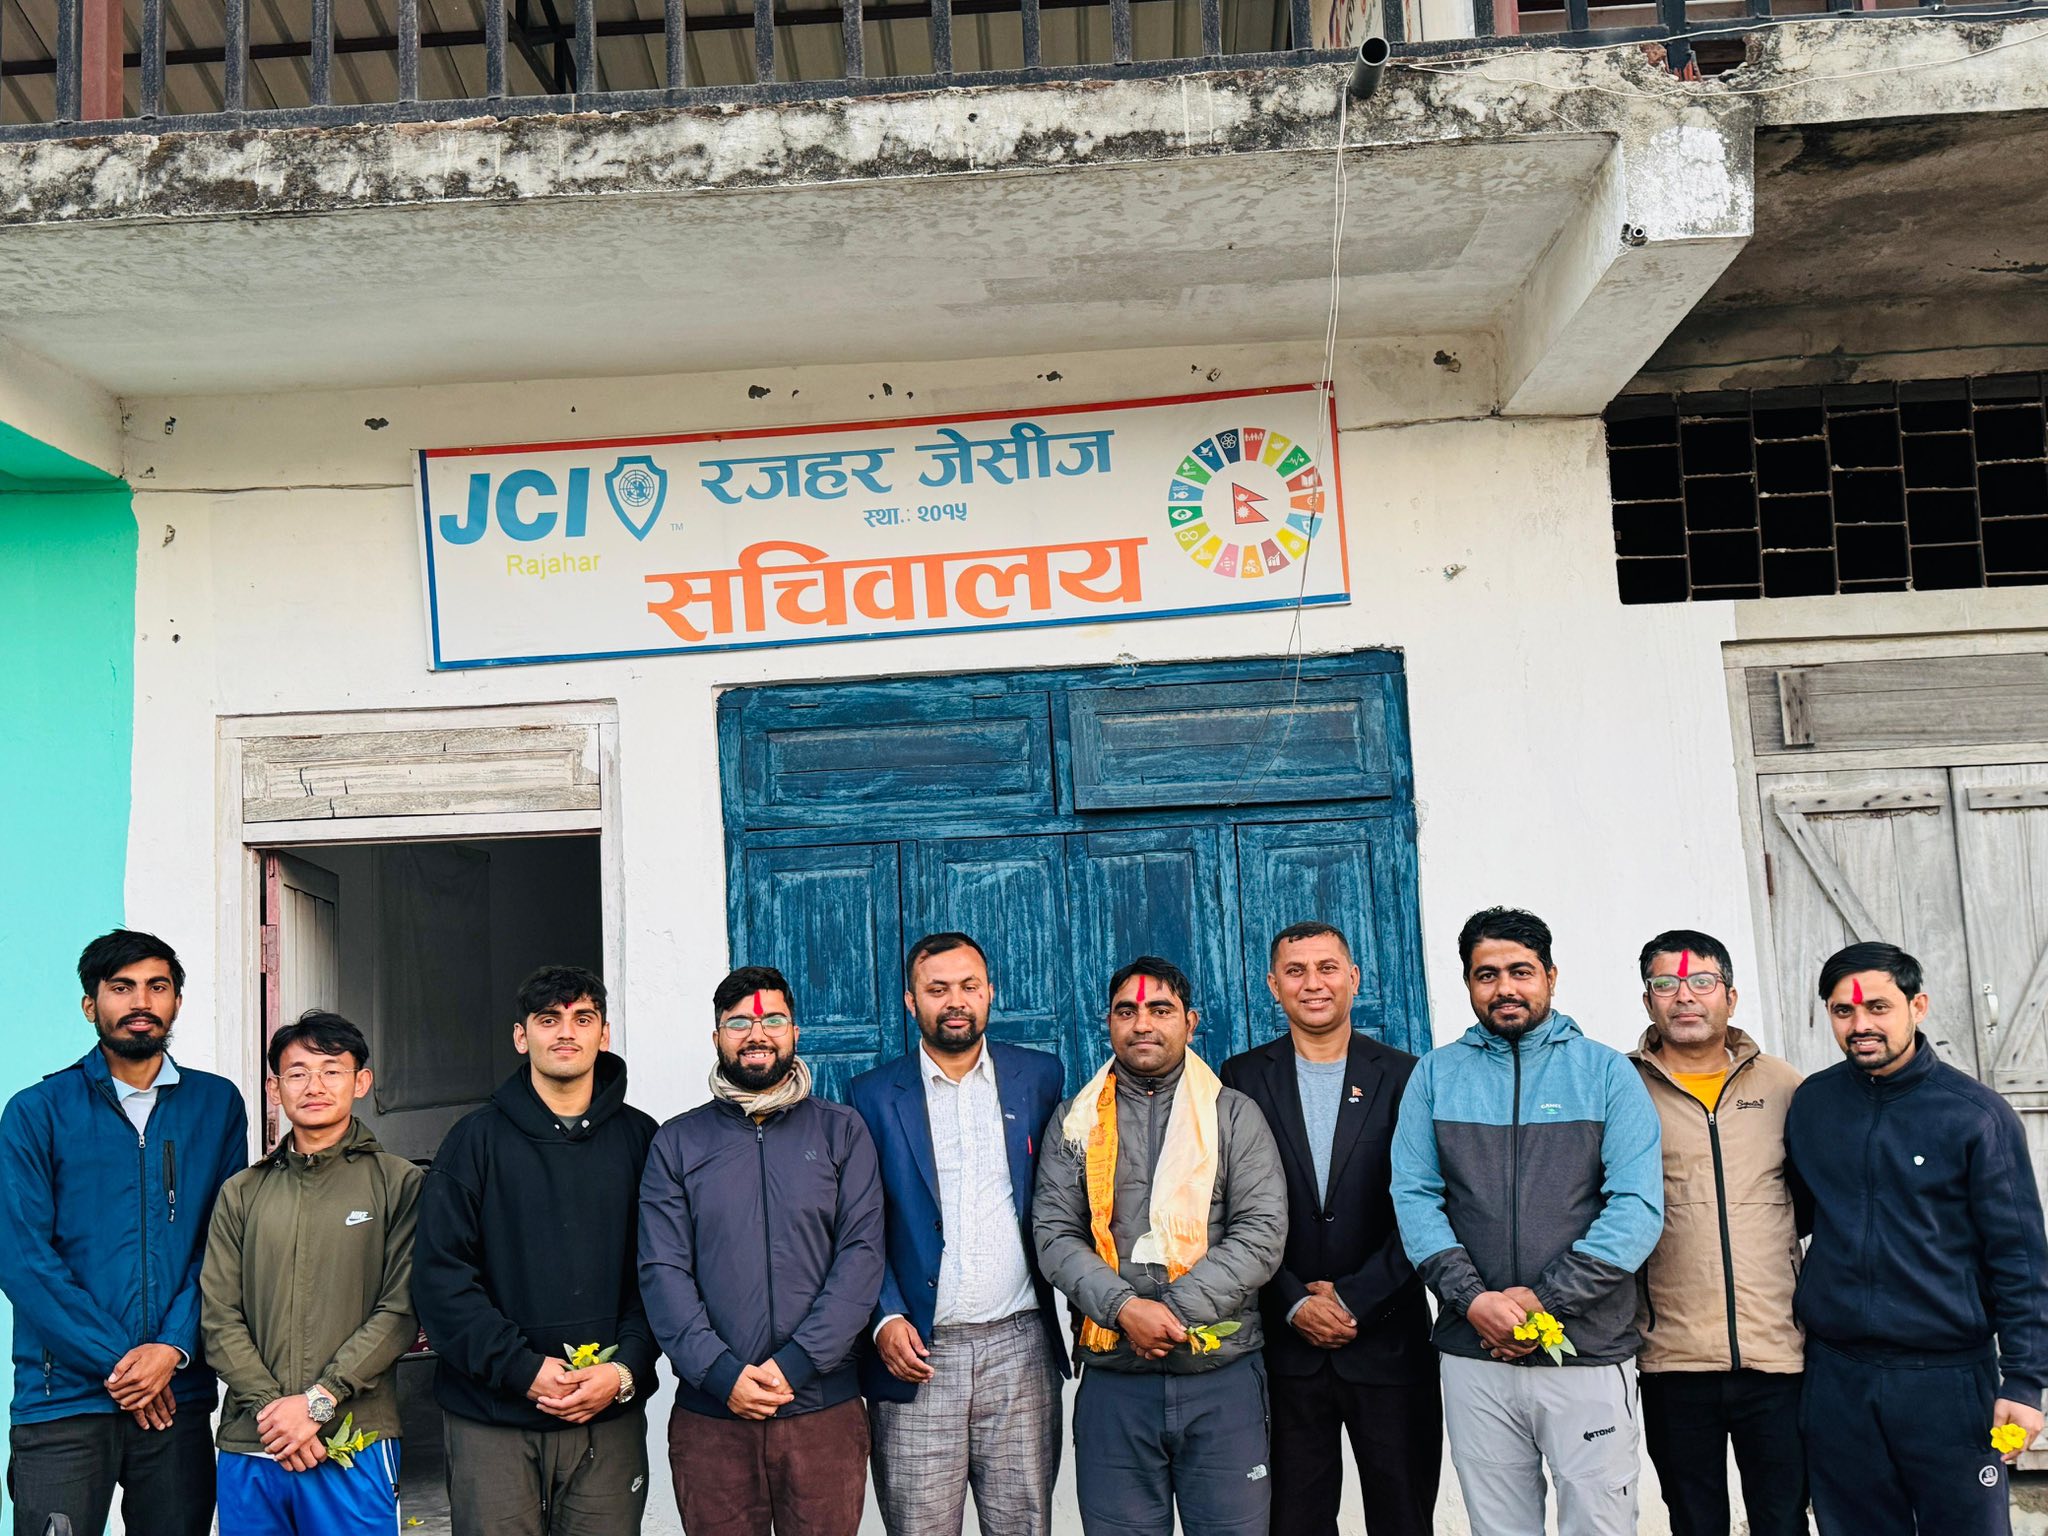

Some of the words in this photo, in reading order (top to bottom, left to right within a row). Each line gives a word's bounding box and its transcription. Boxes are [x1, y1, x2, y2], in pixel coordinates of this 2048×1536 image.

[439, 467, 590, 545] JCI
[917, 502, 968, 522] २०१५
[506, 552, 601, 580] Rajahar
[644, 537, 1149, 642] सचिवालय
